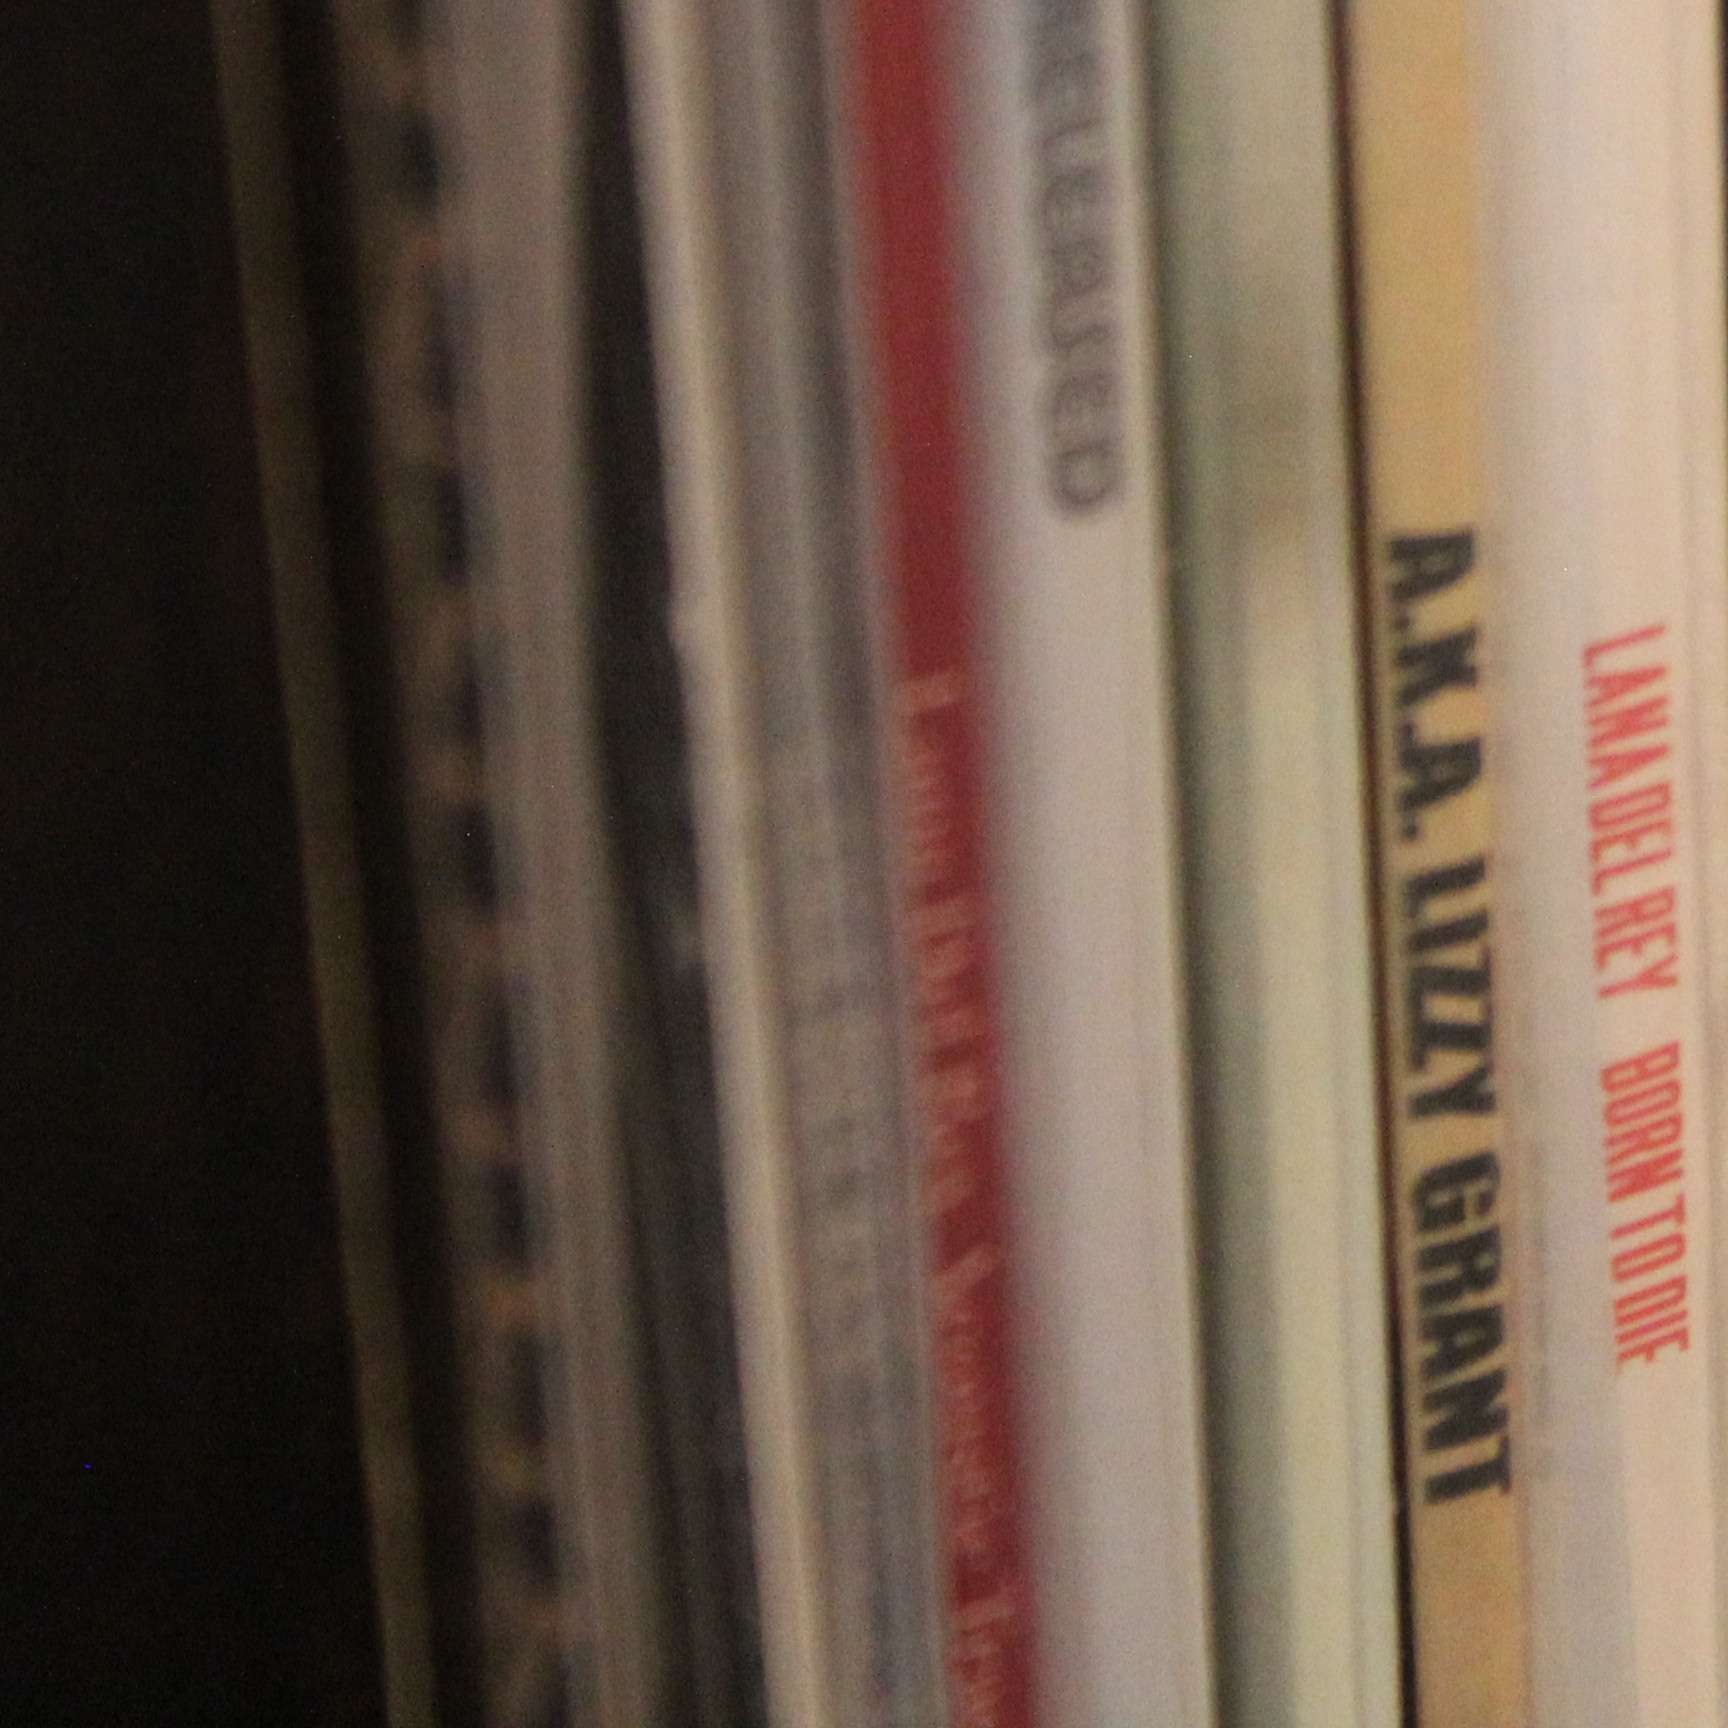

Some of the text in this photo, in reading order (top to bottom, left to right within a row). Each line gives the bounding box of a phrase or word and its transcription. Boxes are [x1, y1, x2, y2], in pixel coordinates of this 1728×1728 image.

[1388, 525, 1511, 1507] A.K.A. LIZZY GRANT
[1584, 624, 1691, 1372] LANA DEL REY BORN TO DIE
